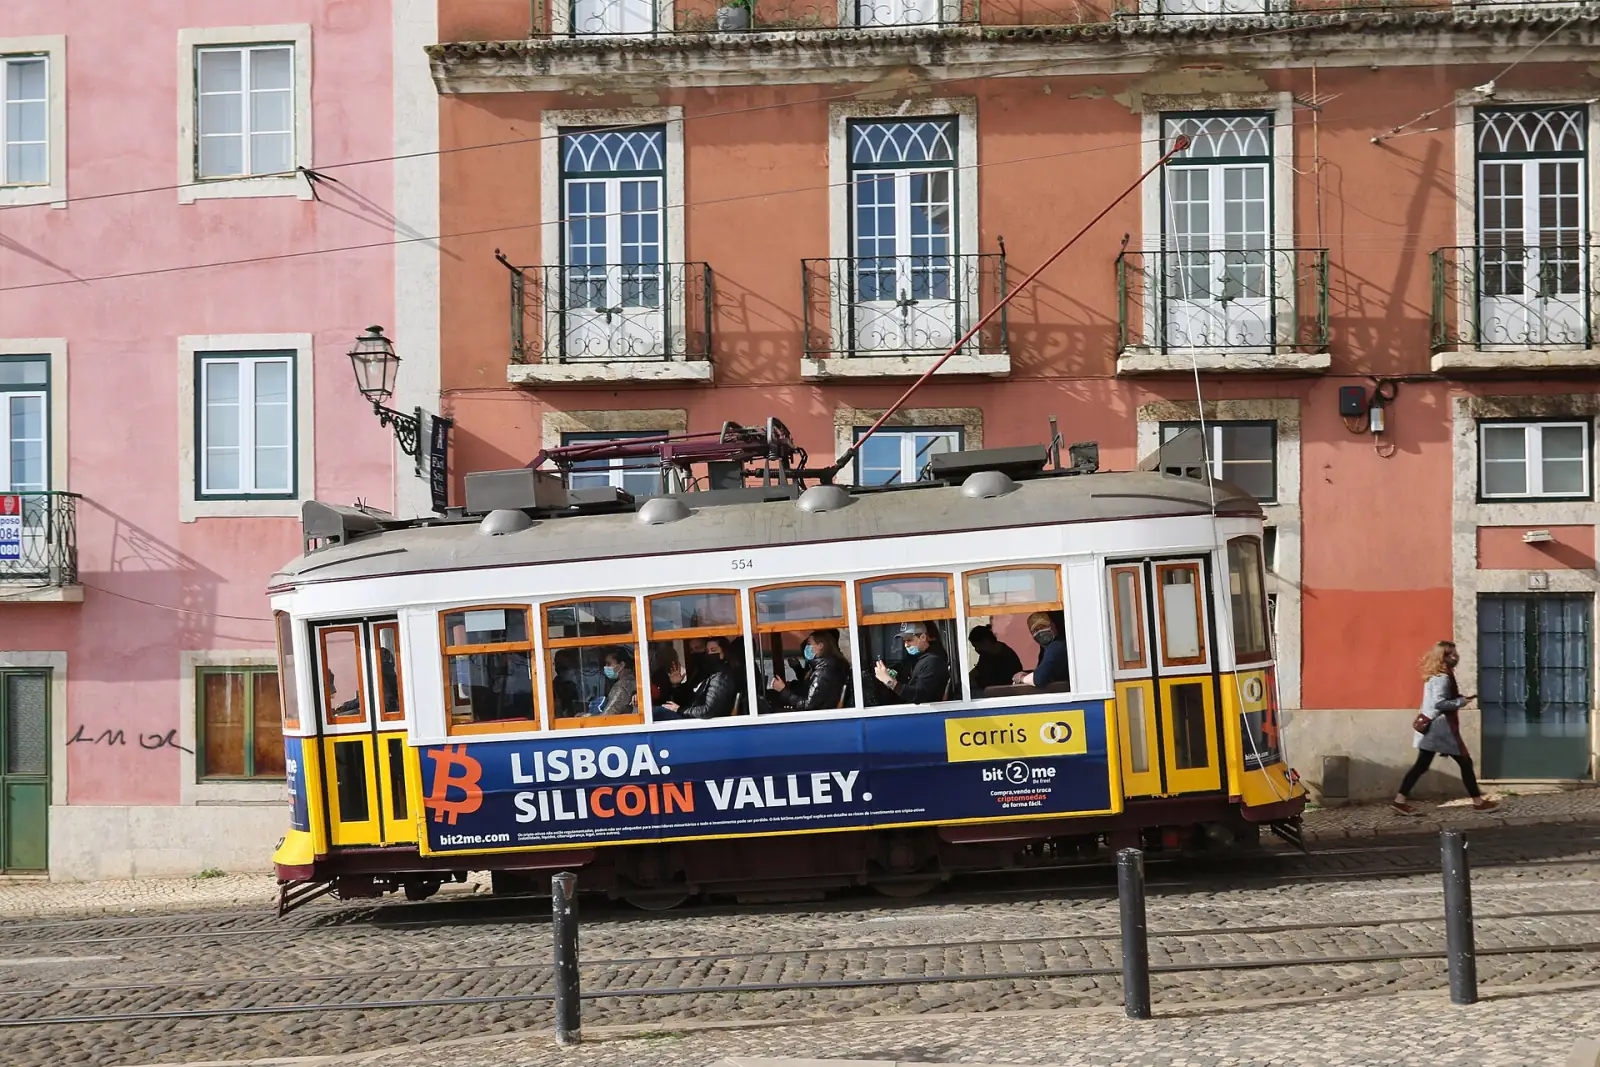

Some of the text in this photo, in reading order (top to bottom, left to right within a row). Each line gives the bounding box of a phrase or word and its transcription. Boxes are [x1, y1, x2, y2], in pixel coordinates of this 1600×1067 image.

[0, 545, 19, 555] 080
[731, 559, 753, 570] 554
[959, 723, 1027, 746] carris
[510, 743, 671, 784] LISBOA:
[513, 770, 873, 823] SILICOIN VALLEY.
[997, 793, 1047, 803] criptomoedas
[440, 831, 510, 847] bit2me.com
